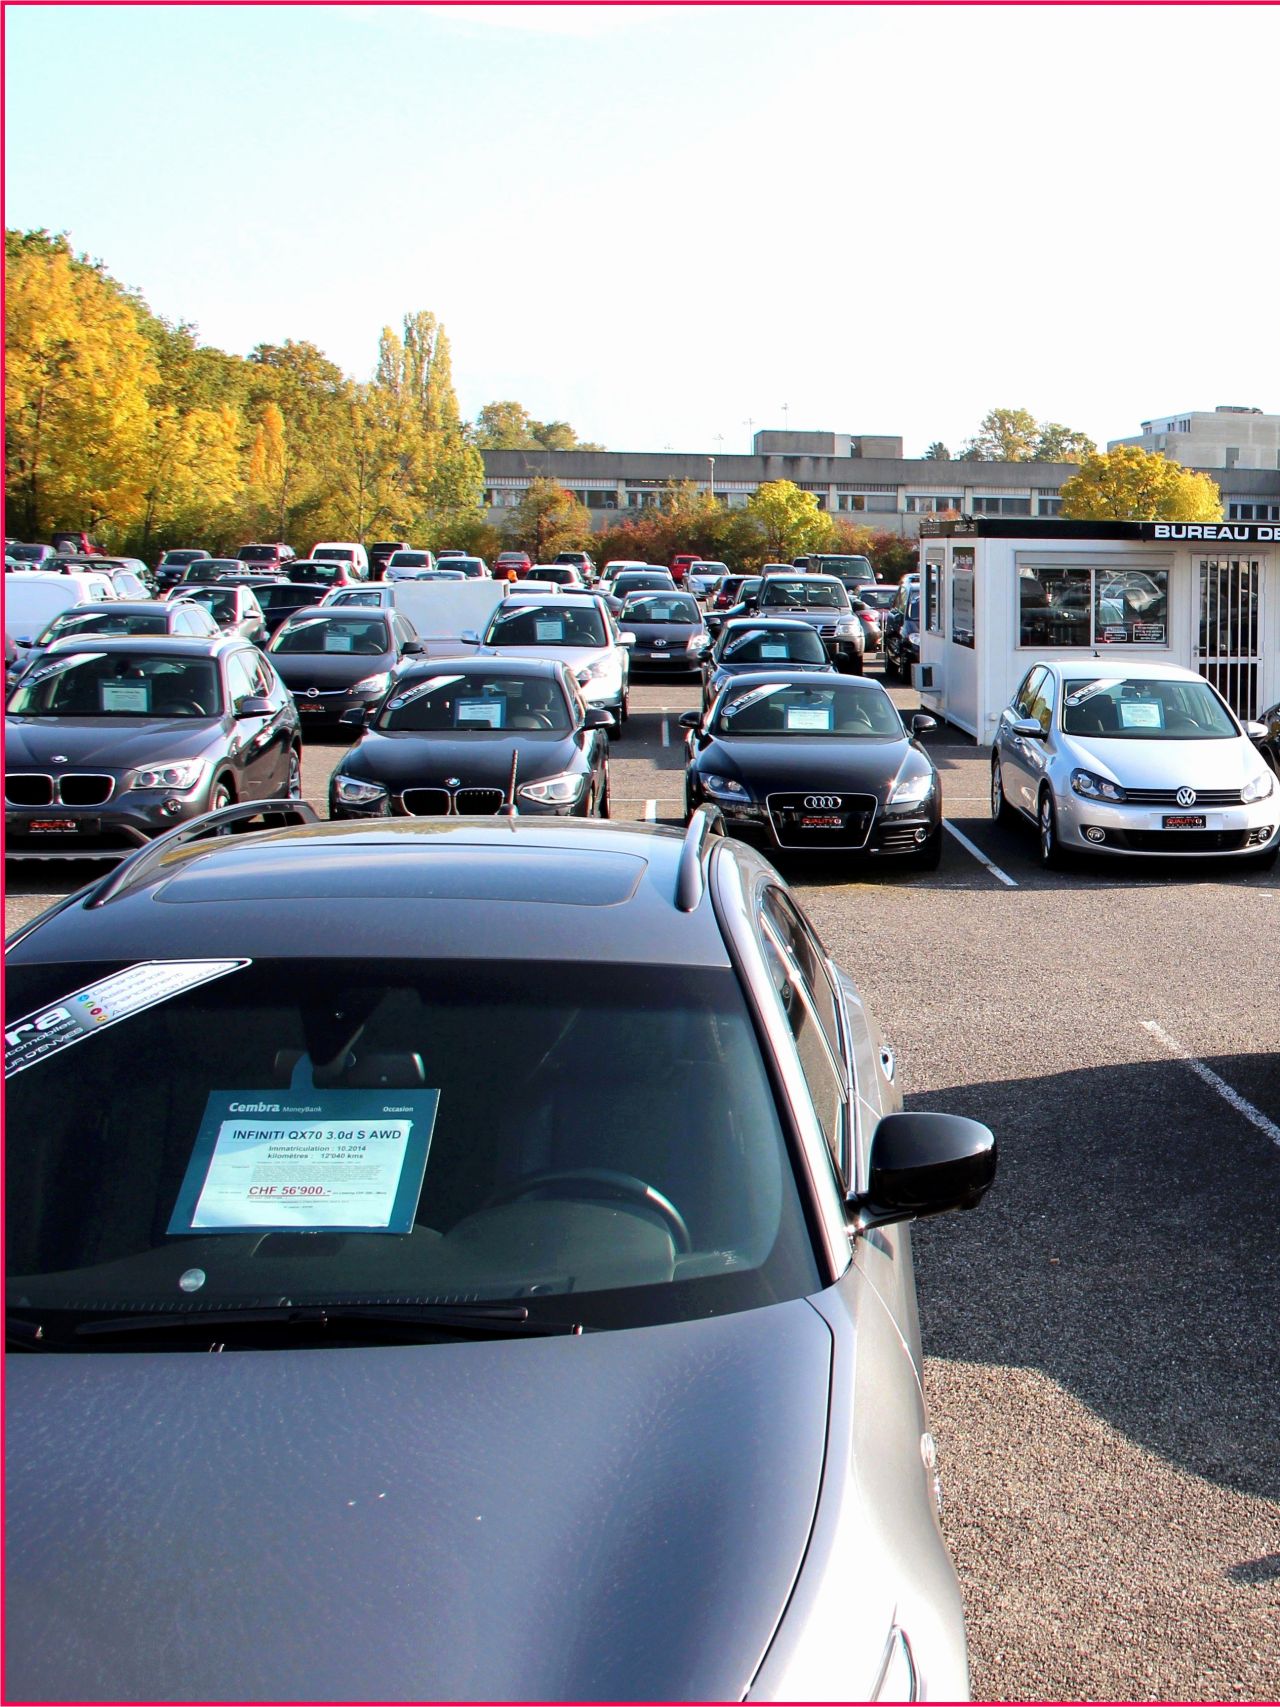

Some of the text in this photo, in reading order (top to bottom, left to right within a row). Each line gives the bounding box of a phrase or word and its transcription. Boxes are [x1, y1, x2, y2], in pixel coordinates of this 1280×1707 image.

[1154, 524, 1250, 541] BUREAU
[229, 1102, 323, 1114] Cembra MoneyBank
[233, 1130, 402, 1140] INFINITI QX70 3.0d S AWD
[249, 1186, 278, 1196] CHF
[281, 1186, 332, 1196] 56'900.-
